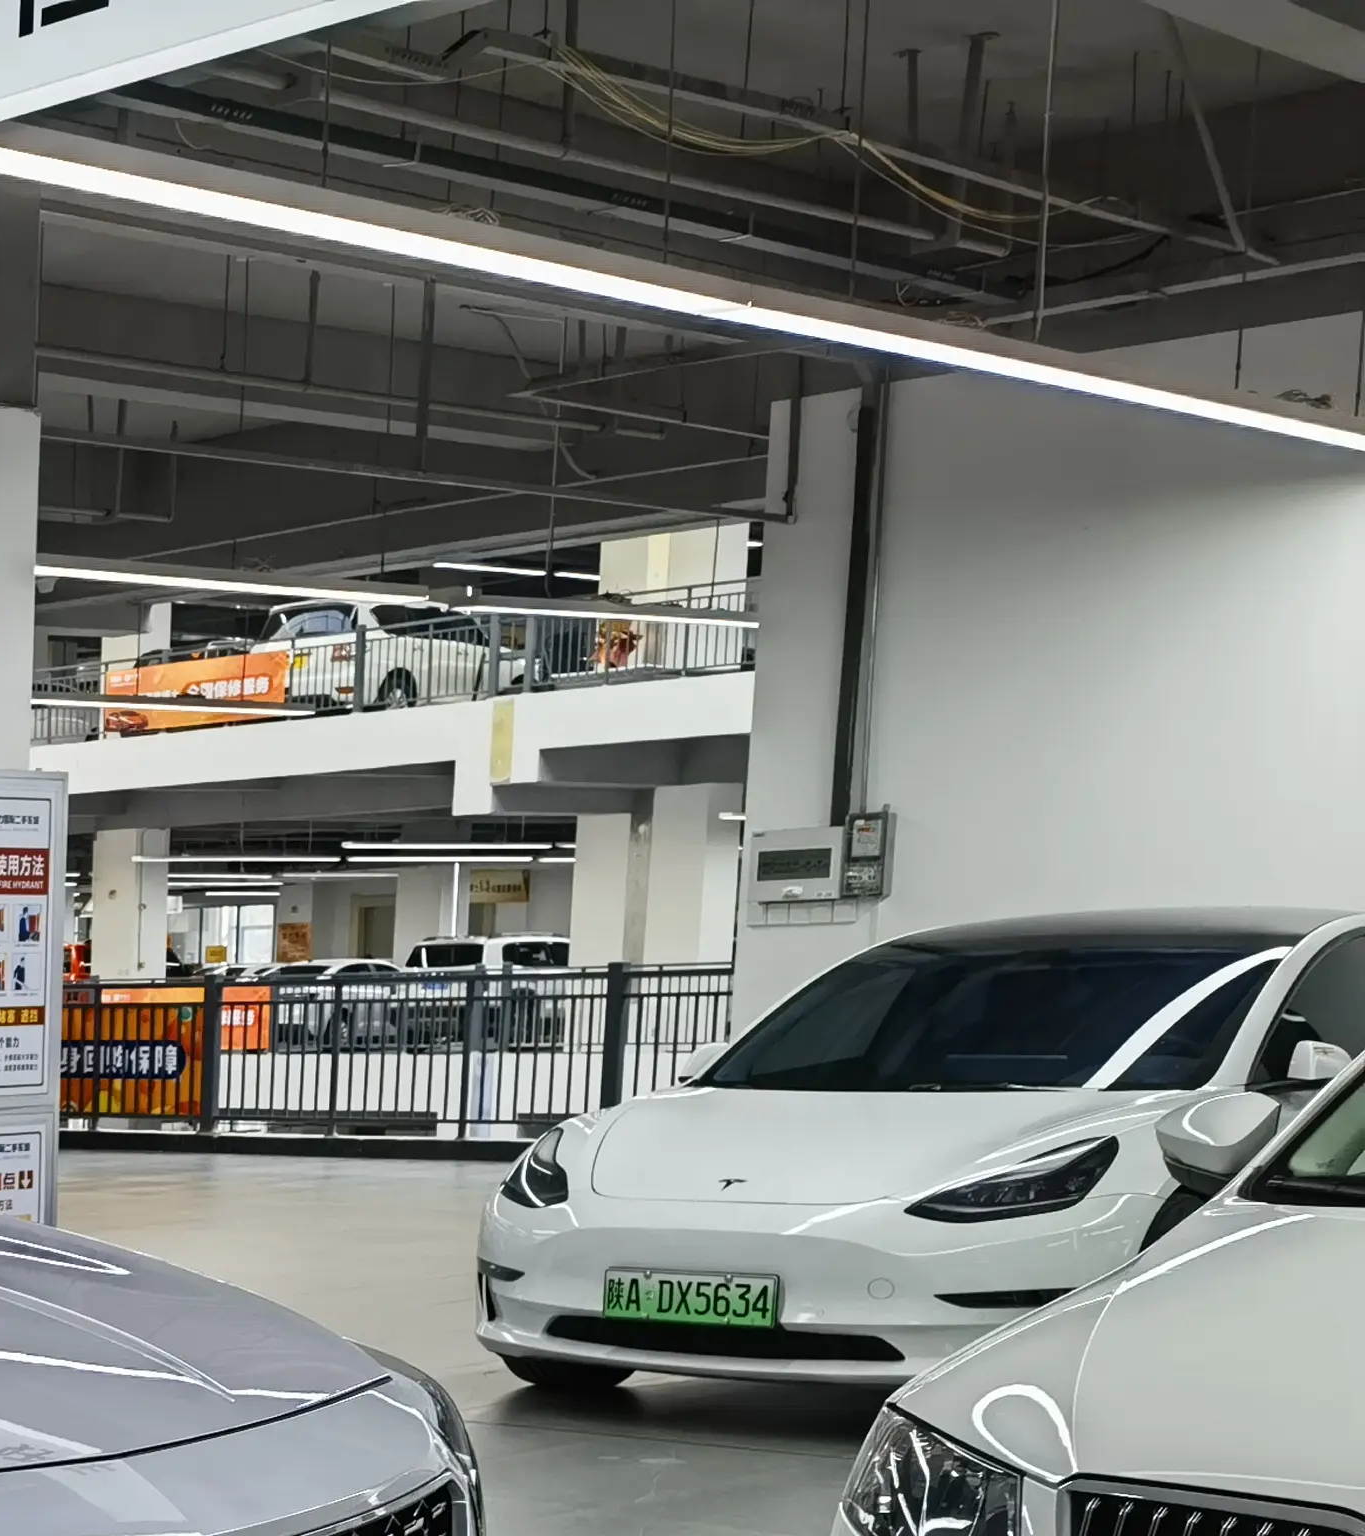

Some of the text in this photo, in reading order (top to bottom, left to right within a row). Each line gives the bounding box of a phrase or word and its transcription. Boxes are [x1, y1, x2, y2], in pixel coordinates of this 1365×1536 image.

[13, 880, 44, 889] HYDRANT
[607, 1278, 770, 1319] 陕A DX5634
